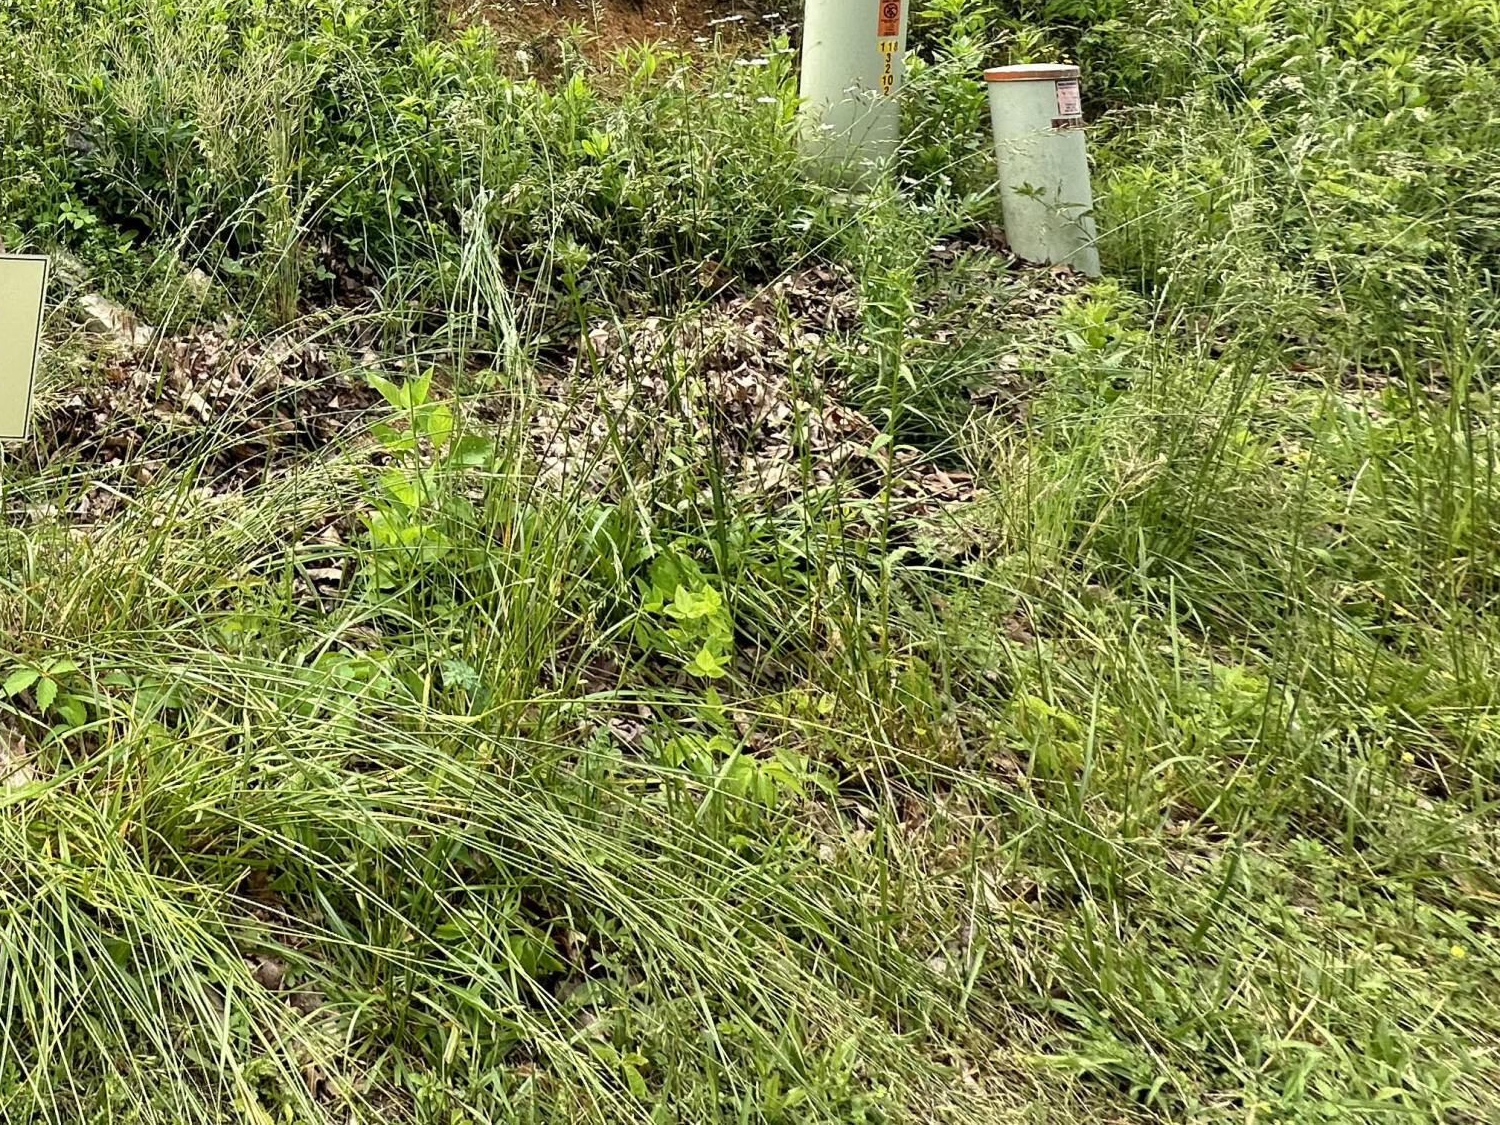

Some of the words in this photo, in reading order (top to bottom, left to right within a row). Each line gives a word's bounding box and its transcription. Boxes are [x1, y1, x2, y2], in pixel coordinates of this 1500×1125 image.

[885, 52, 891, 63] 3
[885, 63, 891, 74] 2
[882, 74, 893, 85] 10
[884, 85, 890, 96] 2
